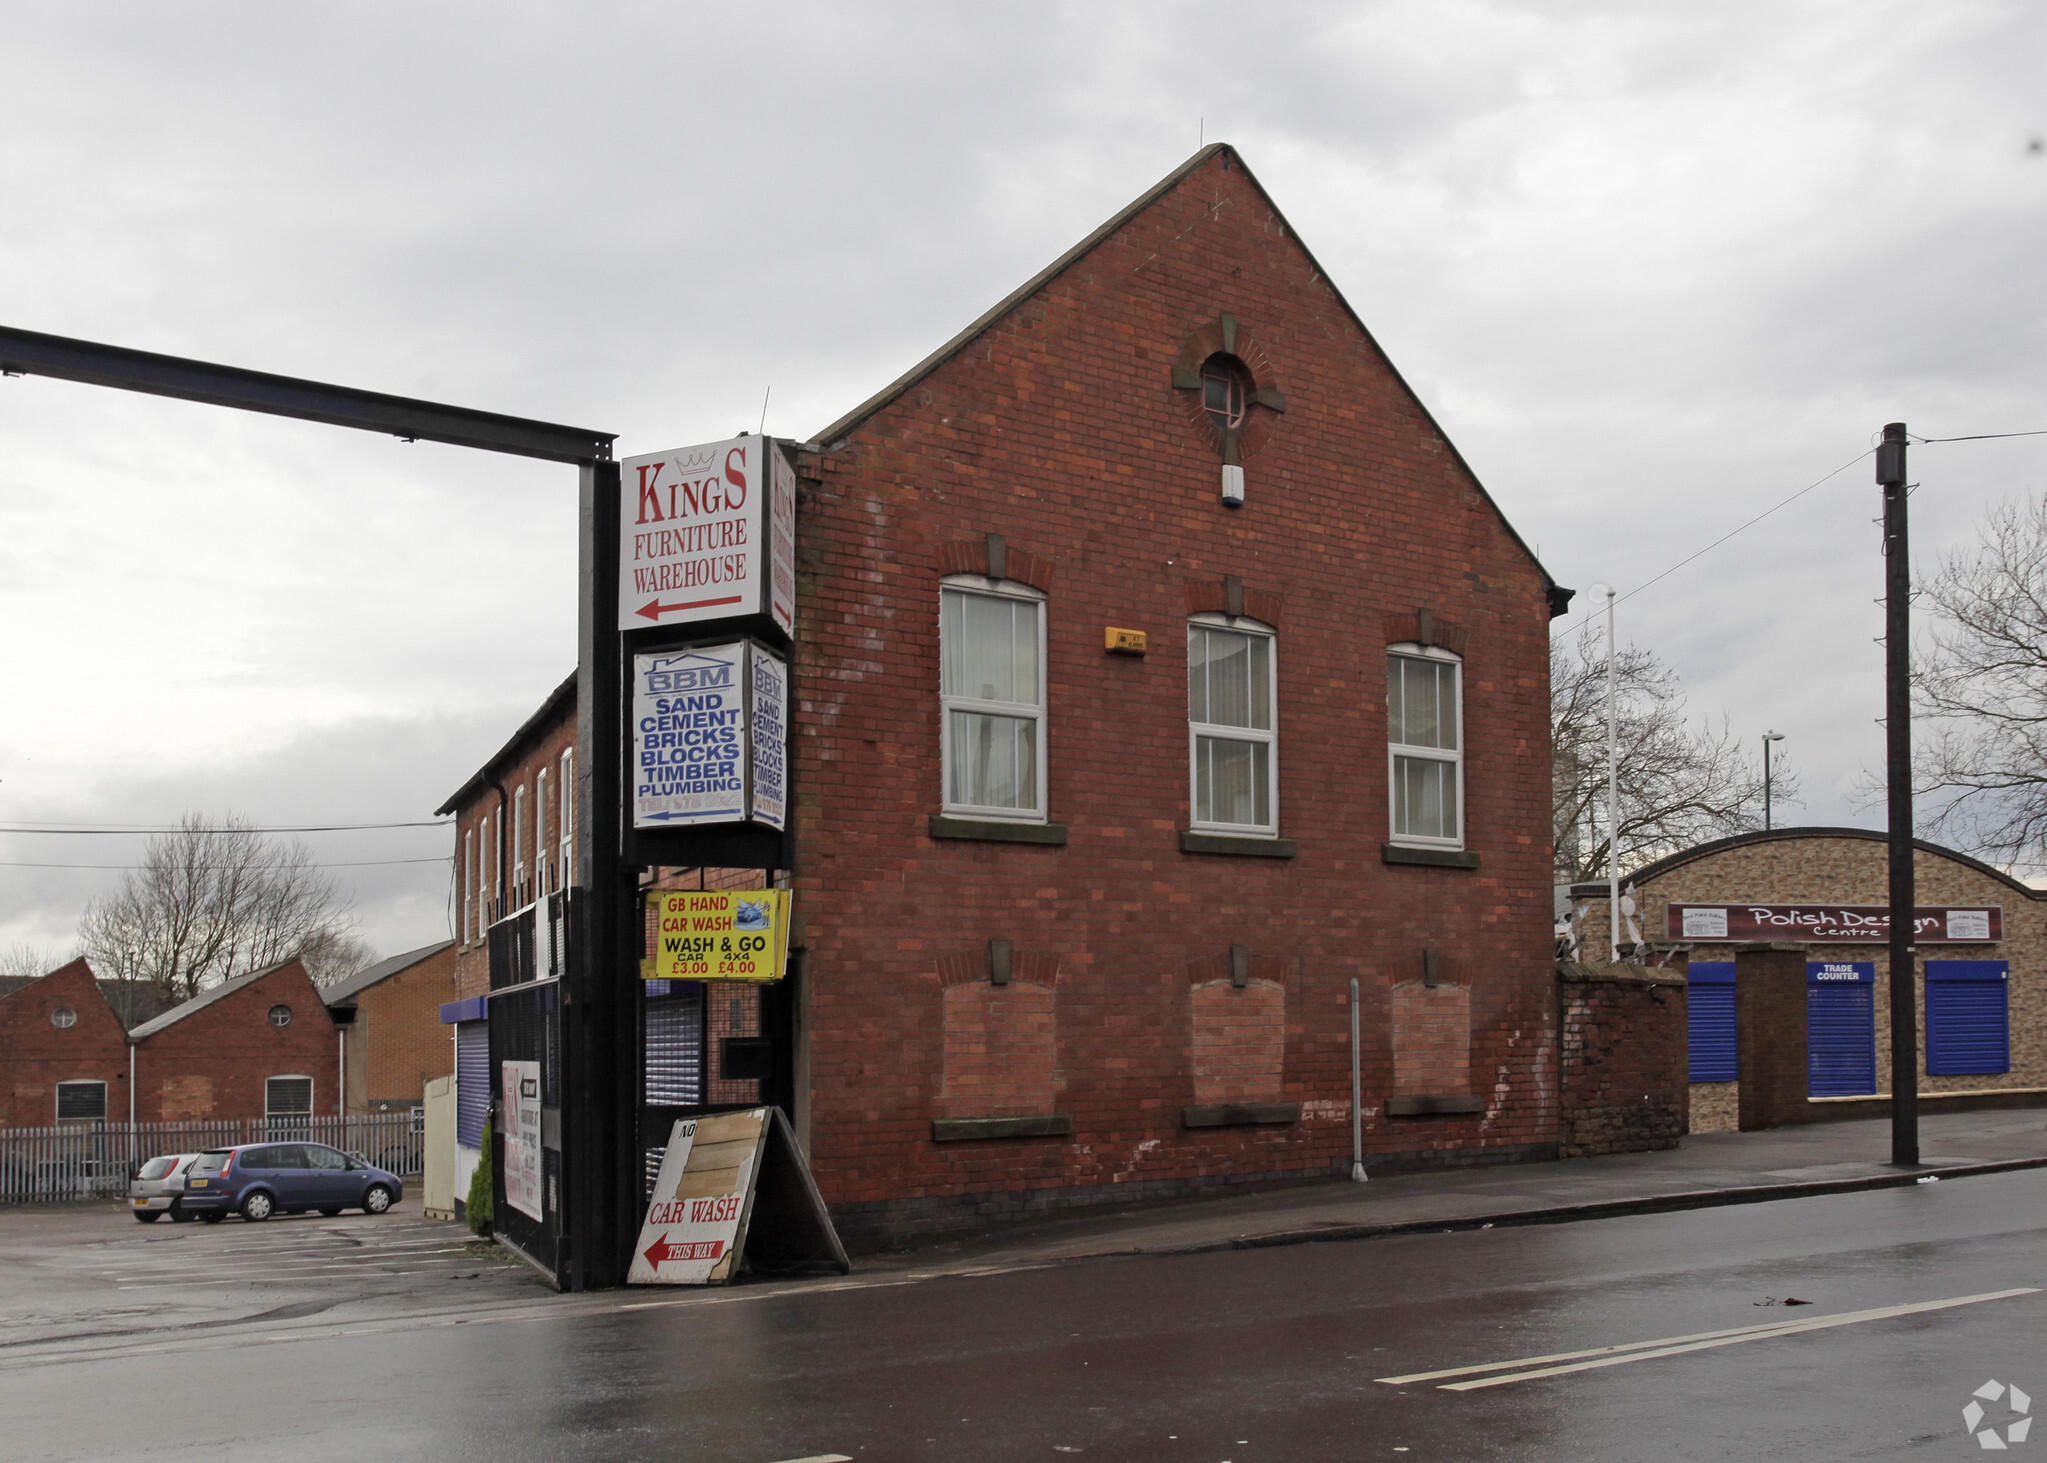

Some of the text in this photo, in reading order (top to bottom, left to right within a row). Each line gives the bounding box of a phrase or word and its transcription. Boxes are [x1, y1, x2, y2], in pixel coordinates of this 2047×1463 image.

[634, 447, 747, 525] KINGS
[634, 518, 747, 560] FURNITURE
[634, 553, 746, 595] WAREHOUSE
[648, 667, 730, 691] BBM
[755, 668, 781, 698] BBM
[656, 694, 722, 715] SAND
[757, 697, 780, 720] SAND
[640, 709, 740, 733] CEMENT
[753, 711, 783, 739] CEMENT
[644, 727, 736, 750] BRICKS
[754, 729, 782, 755] BRICKS
[641, 743, 740, 767] BLOCKS
[754, 745, 783, 772] BLOCKS
[644, 761, 735, 783] TIMBER
[754, 763, 782, 788] TIMBER
[638, 777, 742, 797] PLUMBING
[754, 781, 783, 802] PLUMBING
[668, 896, 729, 912] GB HAND
[662, 916, 732, 932] CAR WASH
[1748, 908, 1837, 925] Polish
[1813, 926, 1881, 936] Centre
[665, 936, 766, 953] WASH & GO
[671, 961, 755, 974] £3.00 £4.00
[677, 952, 750, 962] CAR 4X4
[1824, 964, 1853, 972] TRADE
[1817, 972, 1859, 980] COUNTER
[650, 1197, 741, 1225] CAR WASH
[667, 1243, 716, 1260] THIS WAY
